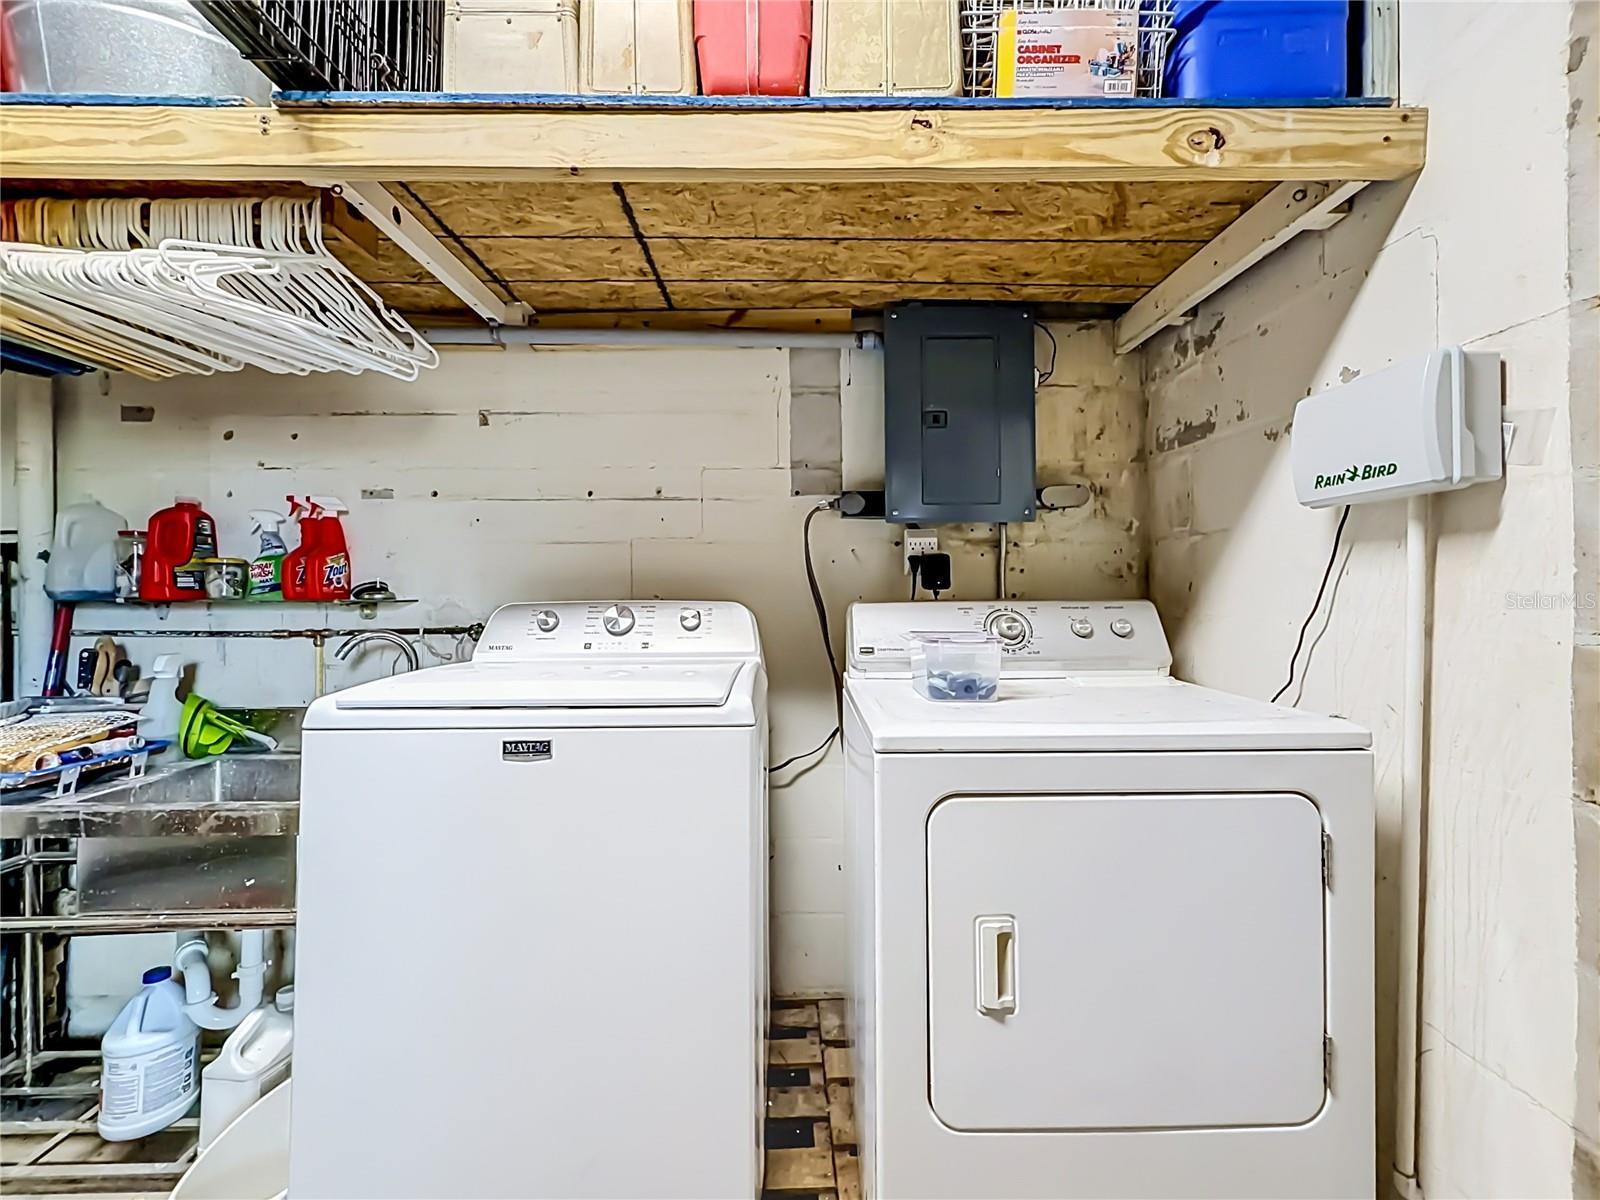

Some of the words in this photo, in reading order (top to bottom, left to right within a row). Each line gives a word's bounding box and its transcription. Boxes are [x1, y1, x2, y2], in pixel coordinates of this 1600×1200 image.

[1017, 45, 1062, 54] CABINET
[1017, 55, 1081, 64] ORGANIZER
[1314, 474, 1346, 489] RAIN
[1361, 463, 1397, 480] BIRD
[323, 563, 347, 584] Zout
[504, 742, 549, 753] MAYTAG
